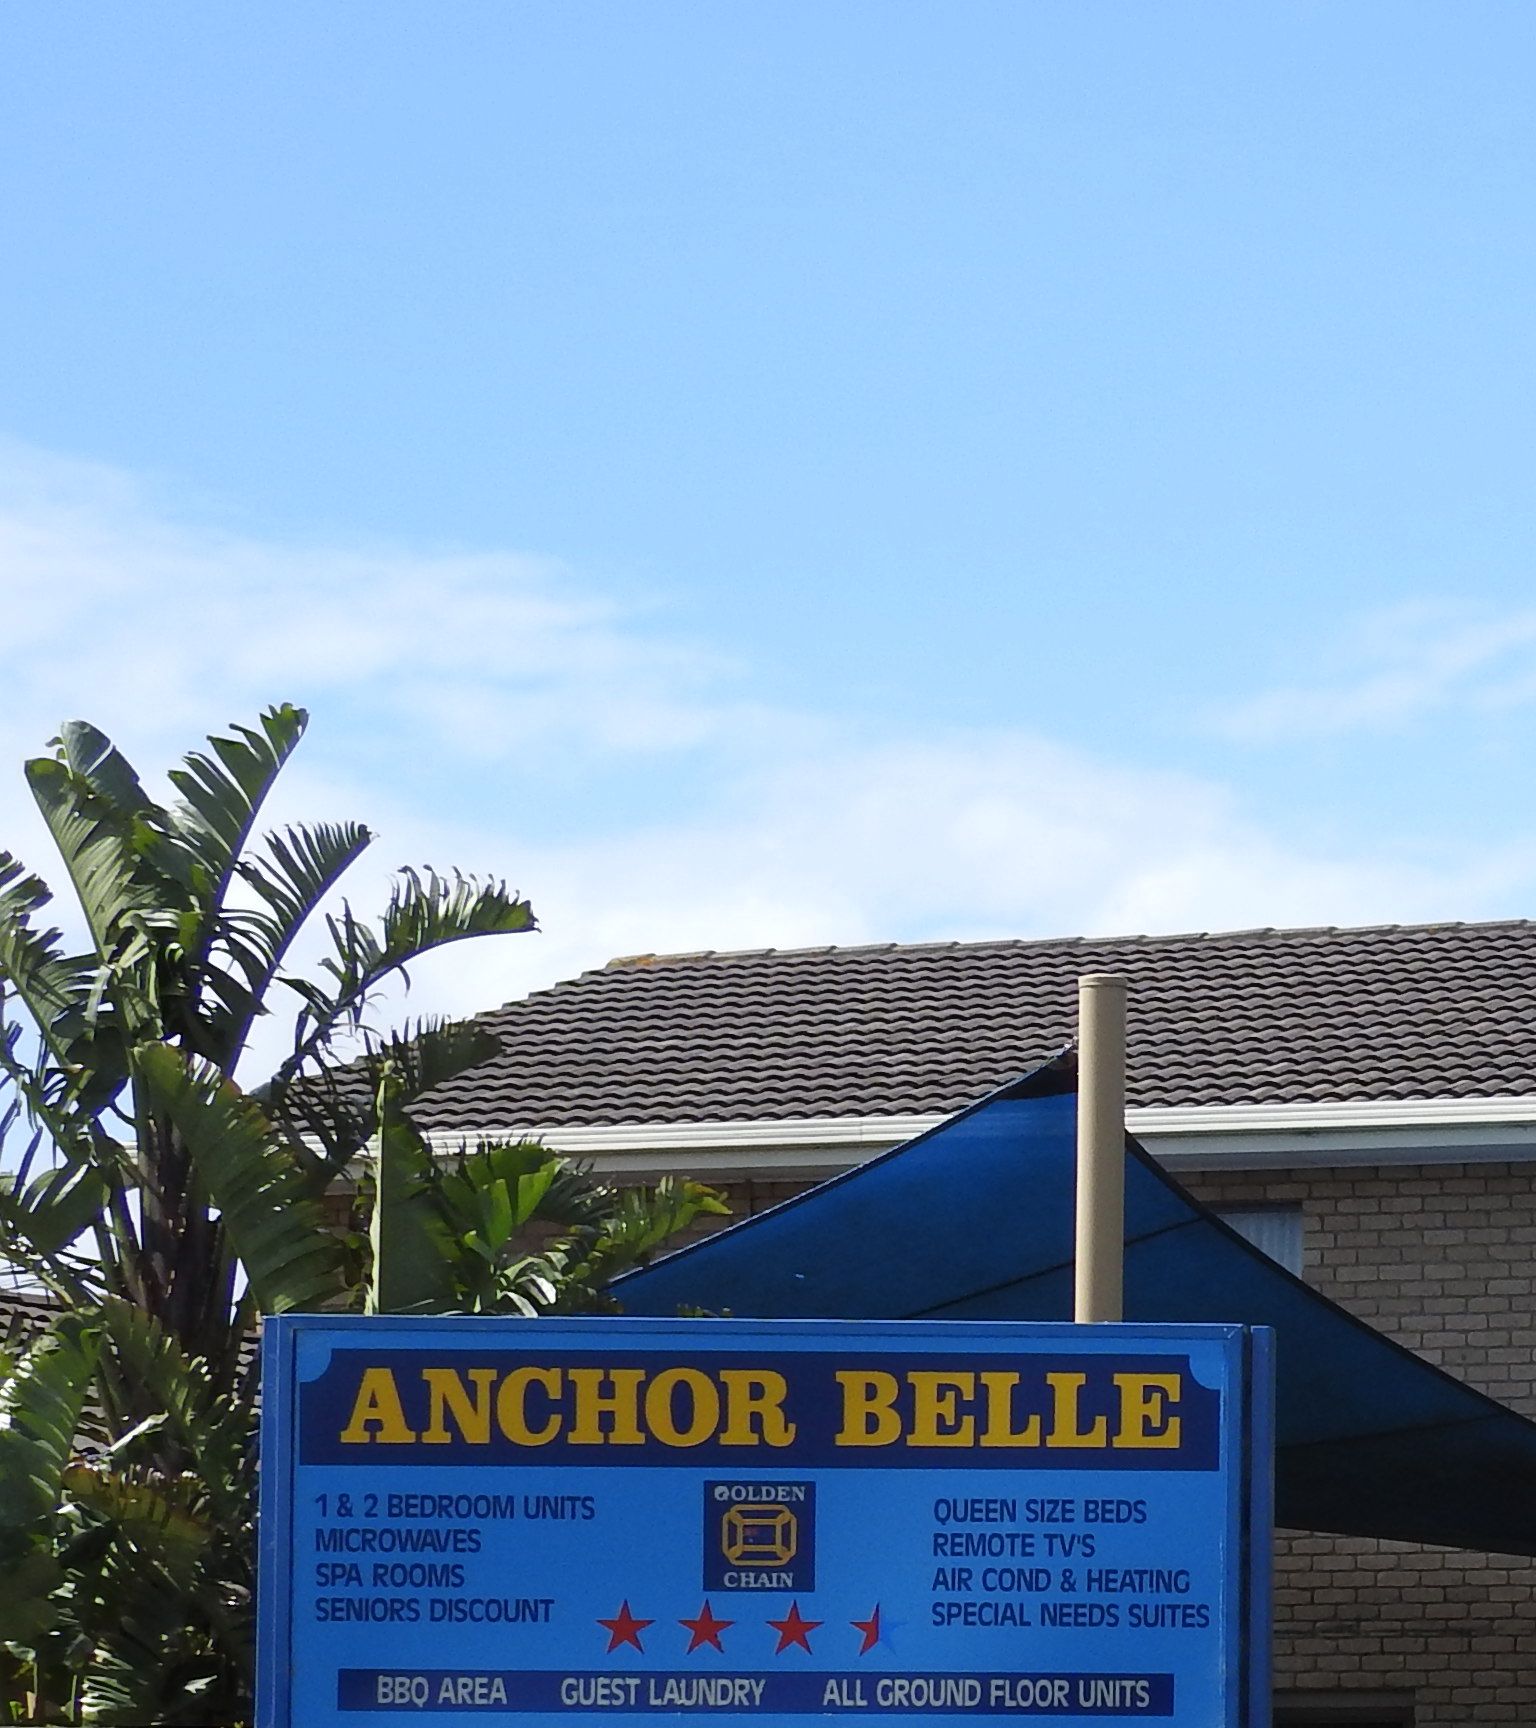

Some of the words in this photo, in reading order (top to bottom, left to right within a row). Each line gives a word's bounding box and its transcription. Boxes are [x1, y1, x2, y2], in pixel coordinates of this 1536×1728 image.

[340, 1367, 796, 1447] ANCHOR
[835, 1370, 1181, 1449] BELLE
[714, 1485, 806, 1501] GOLDEN
[315, 1493, 328, 1518] 1
[336, 1493, 353, 1518] &
[364, 1493, 378, 1518] 2
[387, 1494, 515, 1519] BEDROOM
[523, 1496, 595, 1520] UNITS
[933, 1499, 1017, 1526] QUEEN
[1025, 1499, 1075, 1523] SIZE
[1083, 1500, 1147, 1524] BEDS
[315, 1528, 482, 1552] MICROWAVES
[932, 1533, 1035, 1557] REMOTE
[1044, 1534, 1096, 1558] TV'S
[315, 1563, 363, 1587] SPA
[372, 1563, 465, 1588] ROOMS
[723, 1571, 793, 1588] CHAIN
[931, 1568, 973, 1592] AIR
[982, 1568, 1051, 1592] COND
[1060, 1569, 1077, 1592] &
[1086, 1569, 1190, 1594] HEATING
[315, 1598, 421, 1622] SENIORS
[429, 1598, 555, 1623] DISCOUNT
[931, 1602, 1032, 1627] SPECIAL
[1040, 1604, 1119, 1628] NEEDS
[1128, 1604, 1210, 1628] SUITES
[376, 1675, 430, 1708] BBQ
[438, 1677, 508, 1705] AREA
[560, 1677, 641, 1706] GUEST
[649, 1677, 767, 1706] LAUNDRY
[823, 1679, 868, 1707] ALL
[876, 1678, 982, 1707] GROUND
[990, 1679, 1070, 1708] FLOOR
[1077, 1680, 1150, 1708] UNITS
